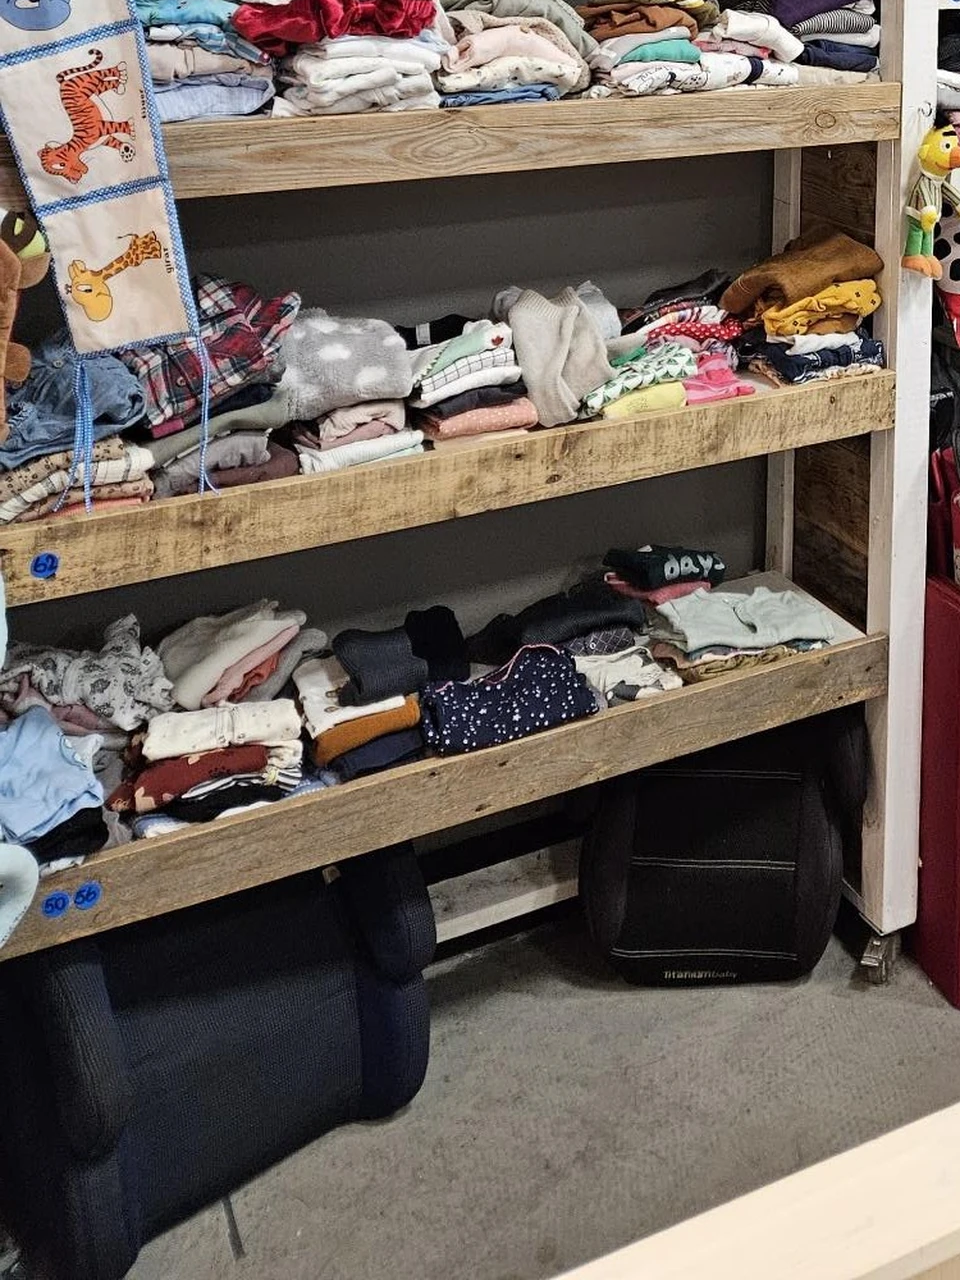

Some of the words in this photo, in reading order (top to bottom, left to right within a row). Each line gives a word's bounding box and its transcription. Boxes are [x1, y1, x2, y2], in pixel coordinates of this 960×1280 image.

[34, 554, 58, 573] 62
[44, 896, 66, 914] 50
[75, 887, 97, 905] 56
